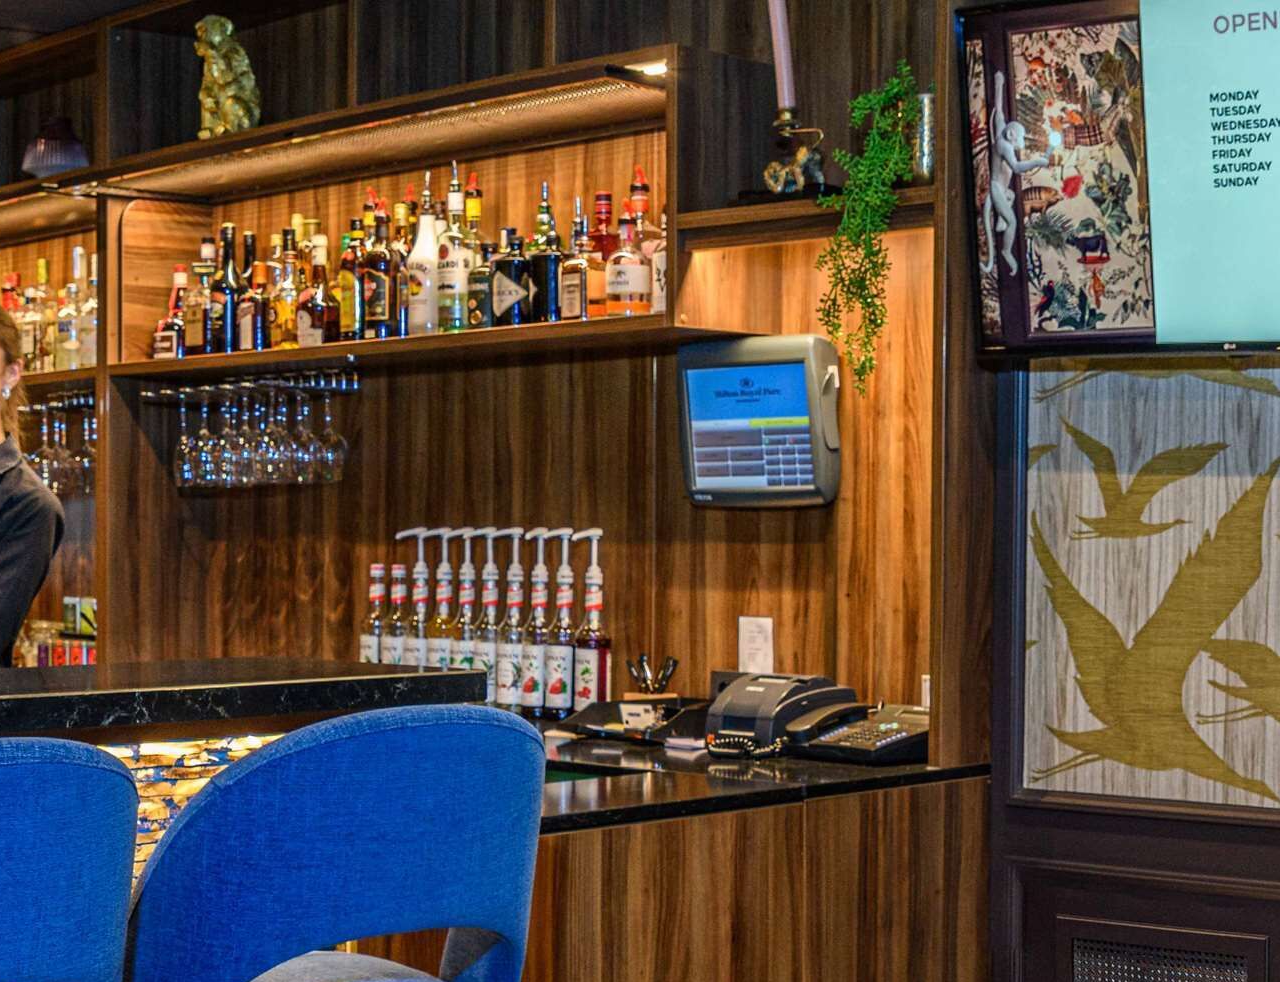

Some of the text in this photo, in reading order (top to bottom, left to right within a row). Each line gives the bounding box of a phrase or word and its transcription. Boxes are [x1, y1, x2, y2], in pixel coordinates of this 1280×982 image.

[1209, 90, 1259, 102] MONDAY
[1209, 104, 1262, 117] TUESDAY
[1211, 132, 1272, 145] THURSDAY
[1212, 148, 1253, 159] FRIDAY
[1213, 161, 1272, 174] SATURDAY
[1213, 176, 1259, 188] SUNDAY
